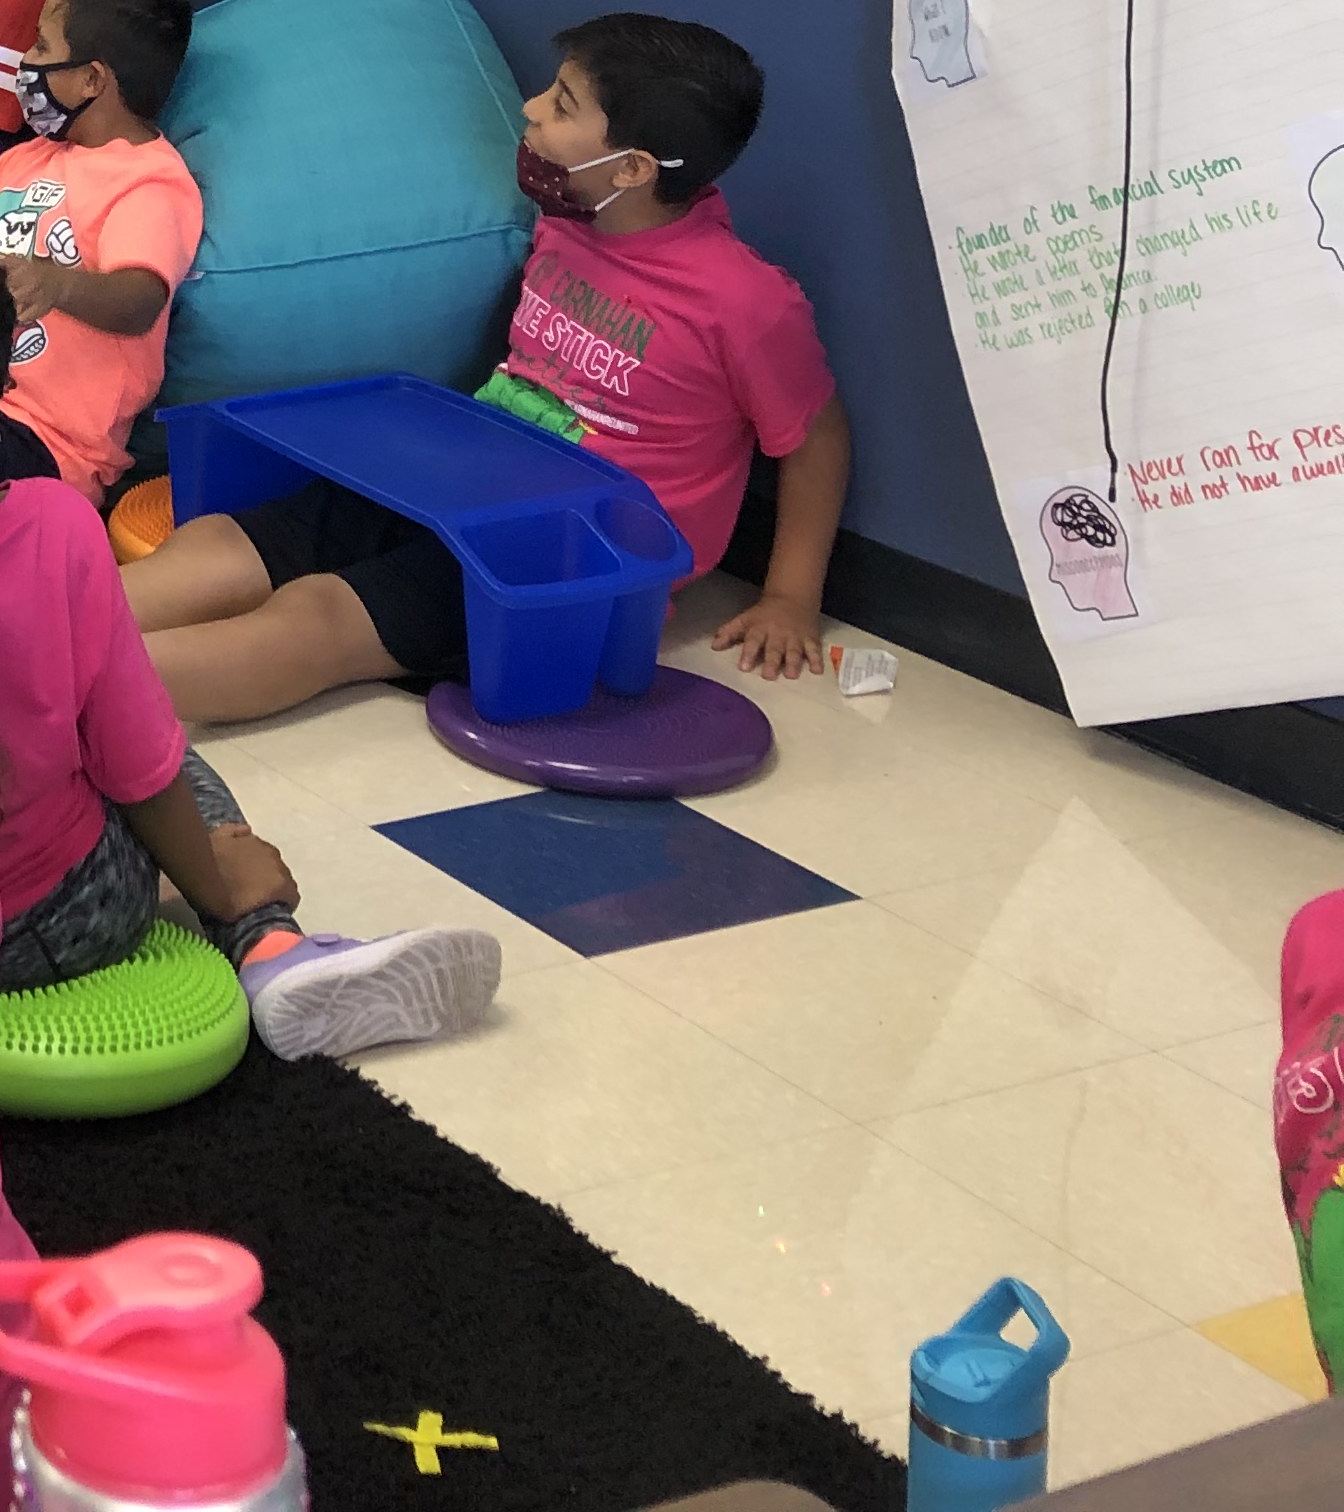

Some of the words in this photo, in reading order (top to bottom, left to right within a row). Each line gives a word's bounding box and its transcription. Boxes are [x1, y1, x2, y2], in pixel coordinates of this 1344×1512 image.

[955, 221, 1011, 260] founder
[1023, 206, 1039, 237] of
[1050, 200, 1078, 226] the
[1167, 153, 1243, 197] system
[961, 254, 985, 282] He
[987, 242, 1037, 274] wrote
[1046, 223, 1104, 265] poems
[967, 281, 990, 305] He
[993, 270, 1030, 298] wrote
[1087, 242, 1122, 272] that
[1135, 219, 1202, 257] changed
[1205, 210, 1233, 234] his
[1236, 198, 1279, 230] life
[549, 268, 658, 364] CARNAHAN
[974, 306, 1002, 331] and
[1010, 295, 1042, 324] sent
[1049, 286, 1078, 312] him
[1080, 280, 1098, 301] to
[979, 329, 1000, 353] He
[1005, 325, 1034, 351] was
[1039, 309, 1096, 346] rejected
[542, 312, 641, 397] STICK
[1127, 452, 1186, 486] Never
[1199, 444, 1242, 472] ran
[1246, 429, 1283, 463] for
[1137, 488, 1164, 513] He
[1169, 481, 1196, 508] did
[1200, 474, 1231, 501] not
[1236, 470, 1283, 494] have
